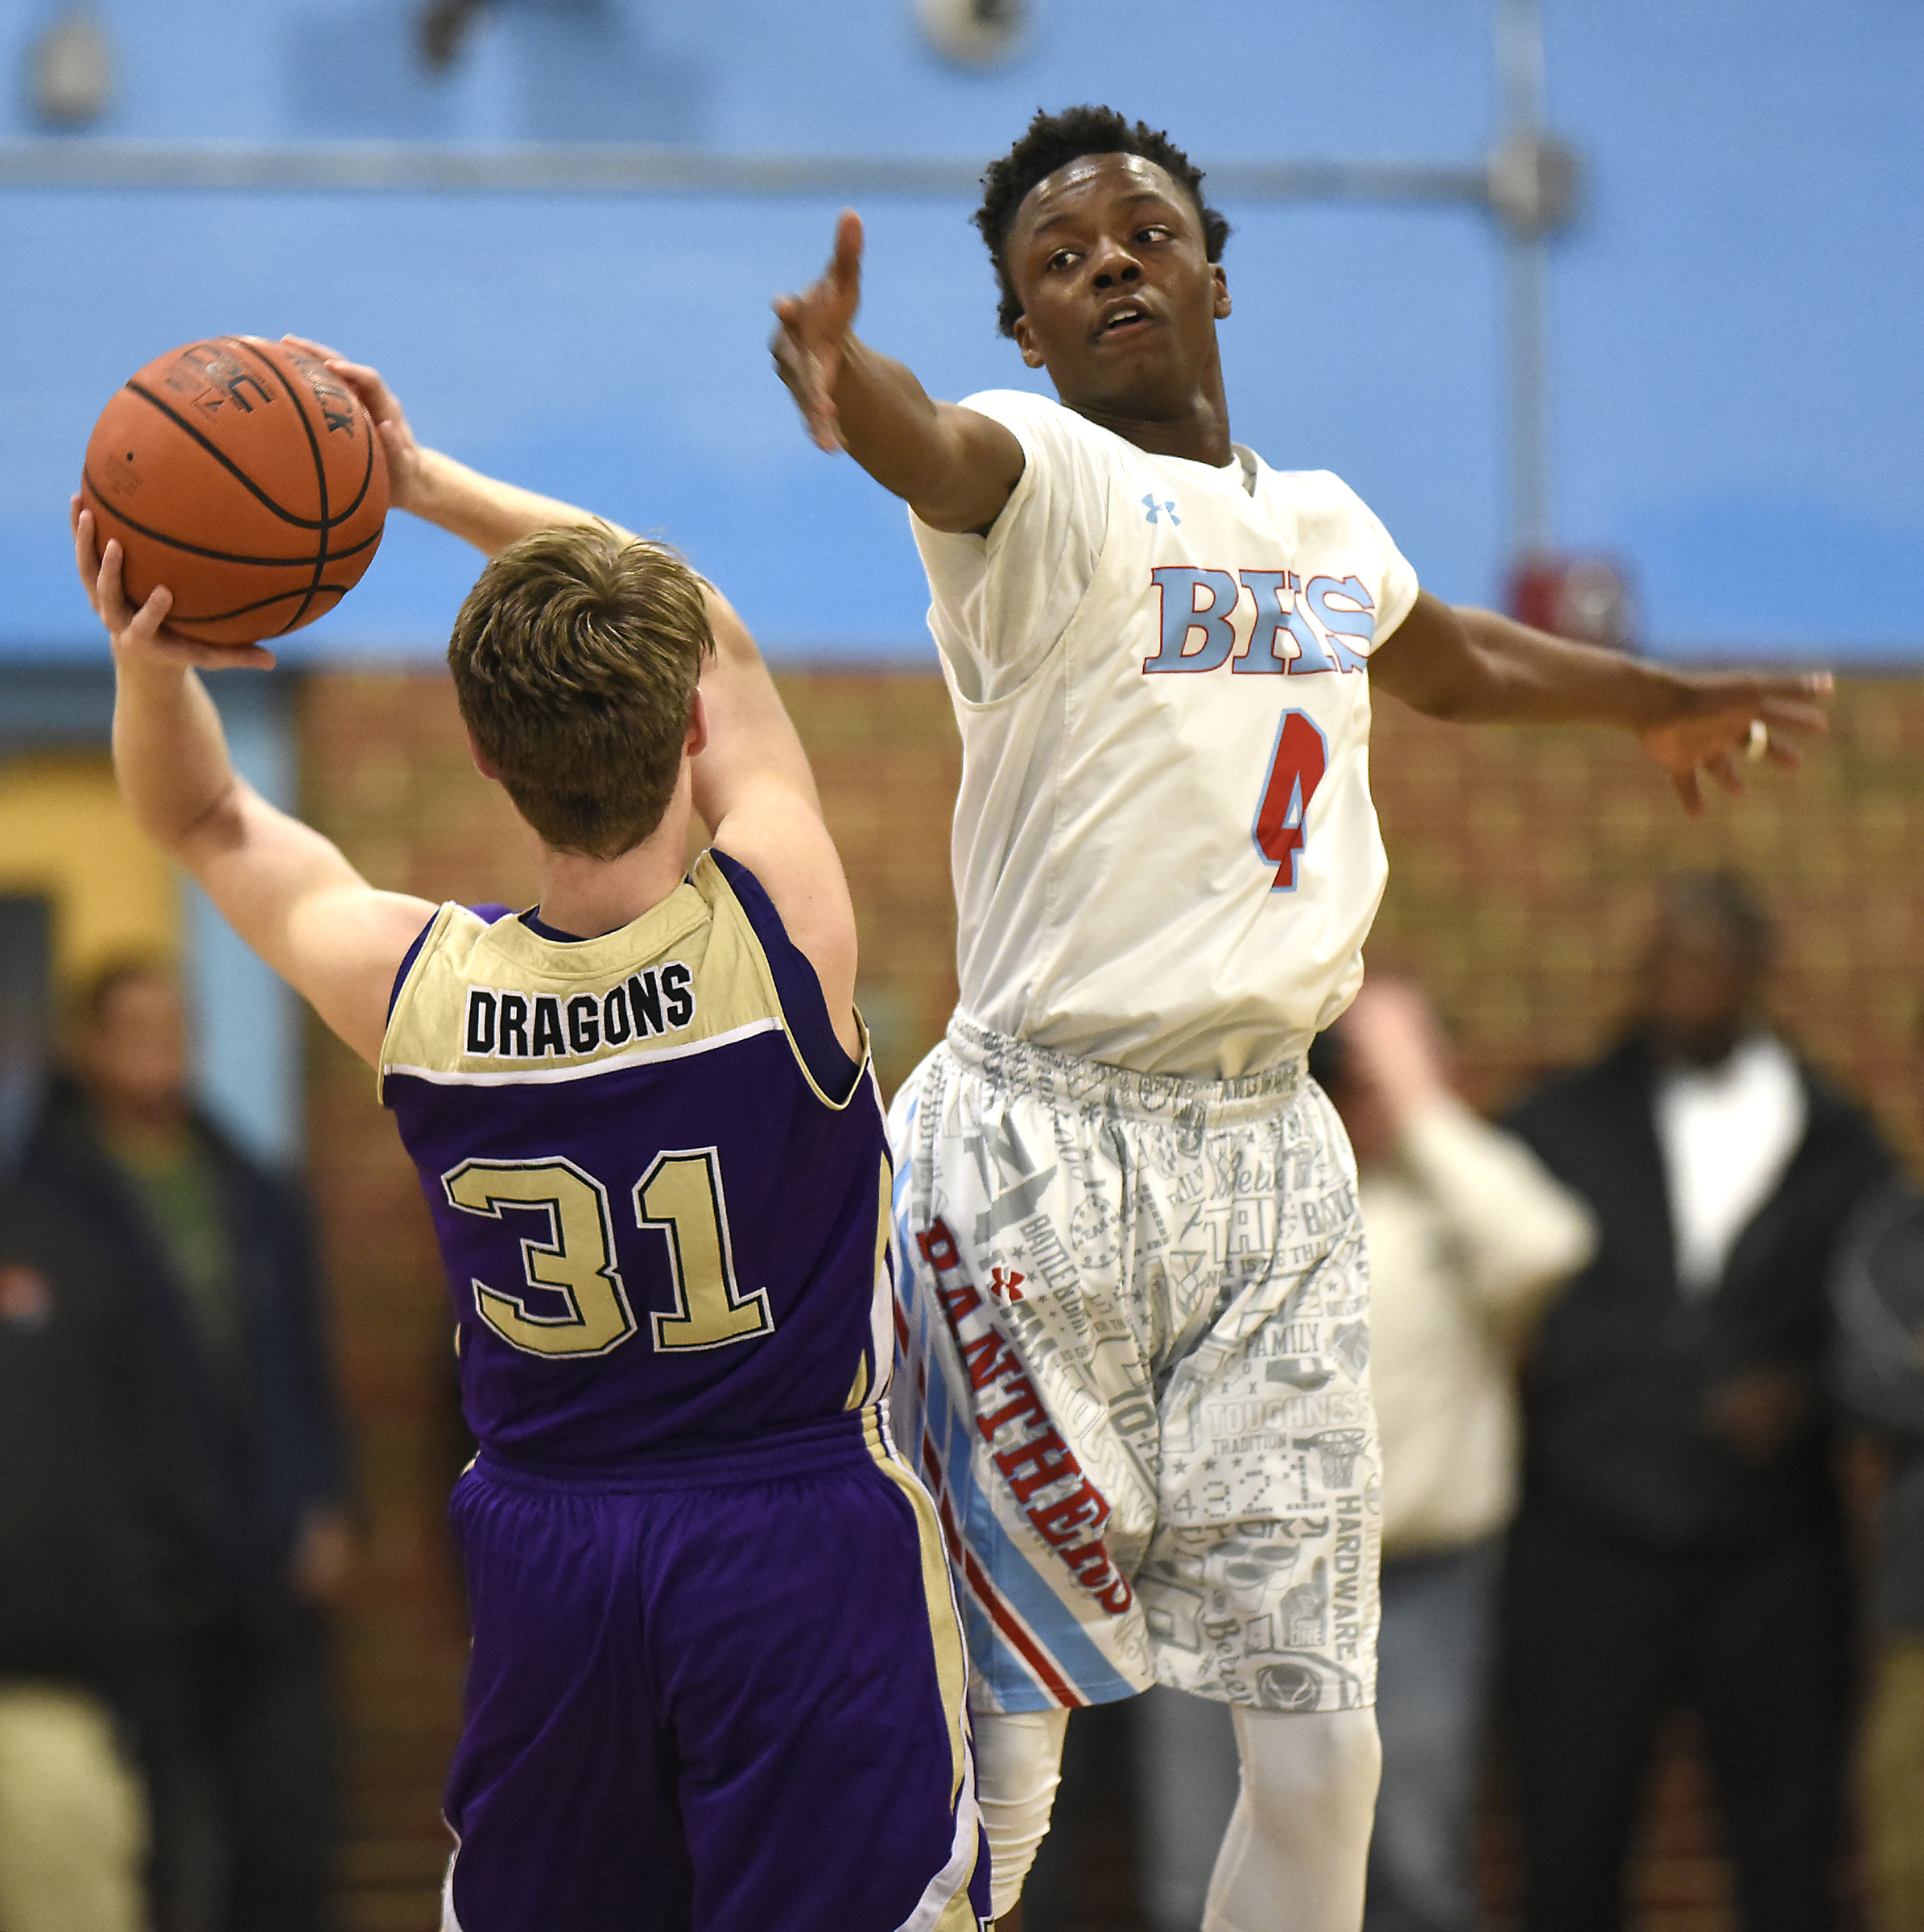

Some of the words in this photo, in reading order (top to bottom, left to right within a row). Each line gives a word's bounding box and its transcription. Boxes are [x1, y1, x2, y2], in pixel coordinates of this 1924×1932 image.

[1142, 566, 1375, 675] BHS
[1251, 708, 1328, 894] 4
[463, 960, 696, 1059] DRAGONS
[440, 1146, 775, 1360] 31
[1249, 1323, 1320, 1359] AMILY
[1334, 1493, 1362, 1662] HARDWARE
